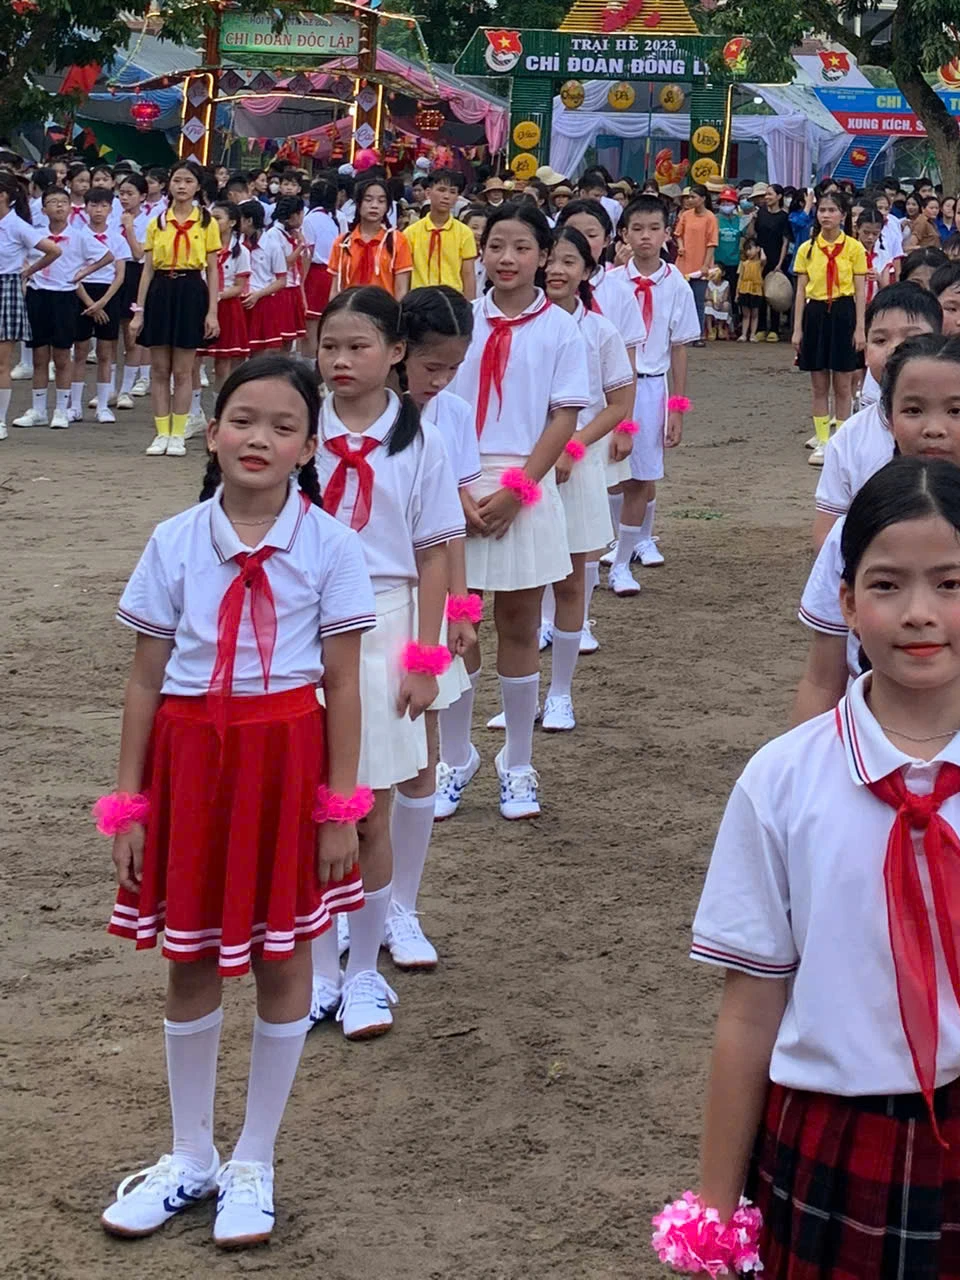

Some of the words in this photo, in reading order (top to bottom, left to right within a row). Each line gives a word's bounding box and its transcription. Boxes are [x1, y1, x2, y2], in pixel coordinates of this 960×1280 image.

[225, 32, 248, 45] CHI
[571, 38, 608, 53] TRẠI
[615, 36, 639, 51] HÈ
[644, 39, 677, 51] 2023
[567, 54, 624, 74] ĐOÀN
[631, 52, 686, 75] ĐỒNG
[876, 94, 902, 109] CHI
[848, 117, 879, 130] XUNG
[882, 116, 912, 132] KÍCH,
